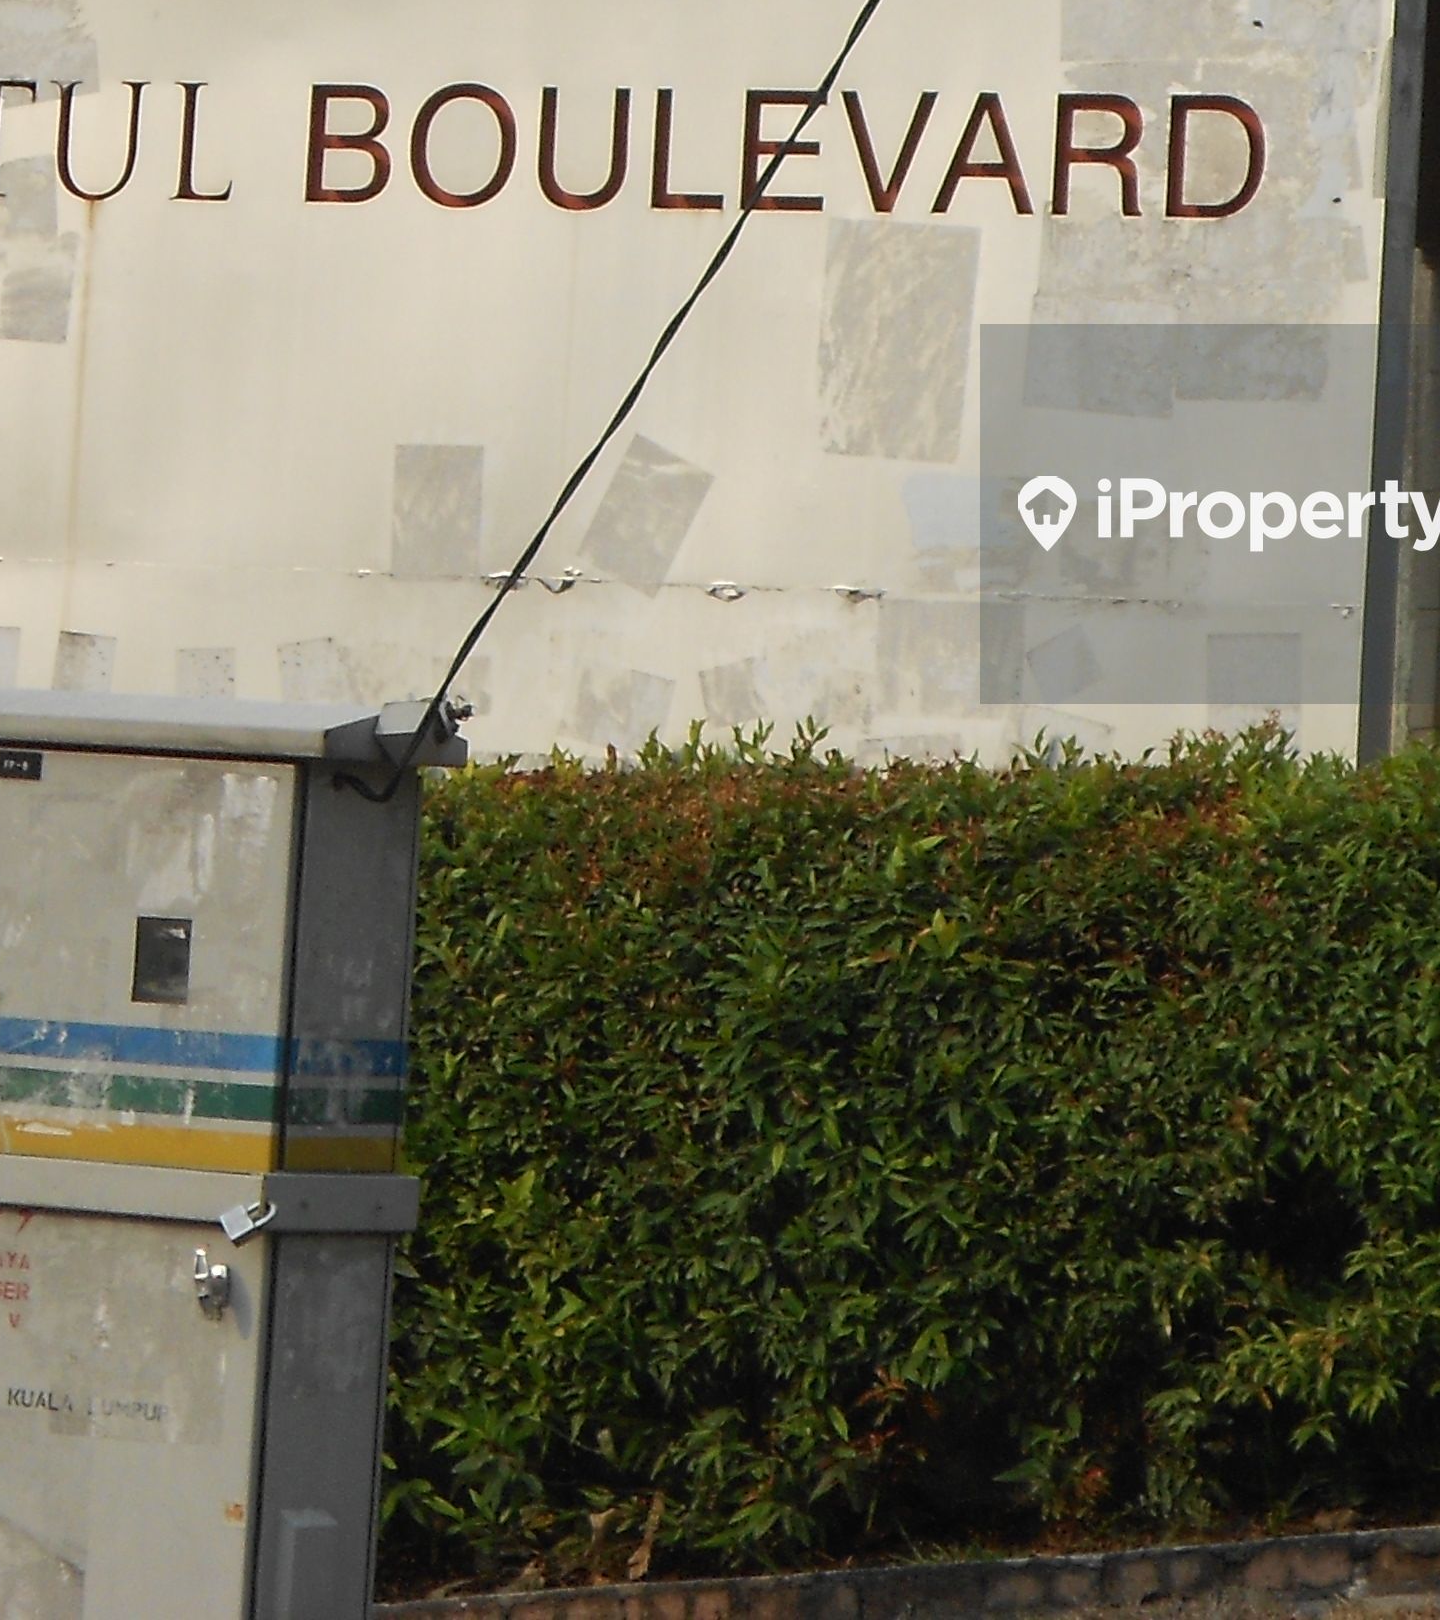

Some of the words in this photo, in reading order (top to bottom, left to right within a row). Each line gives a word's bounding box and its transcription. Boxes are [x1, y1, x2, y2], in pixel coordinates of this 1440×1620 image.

[303, 82, 1267, 220] BOULEVARD
[8, 1312, 21, 1328] V
[7, 1387, 75, 1414] KUALA
